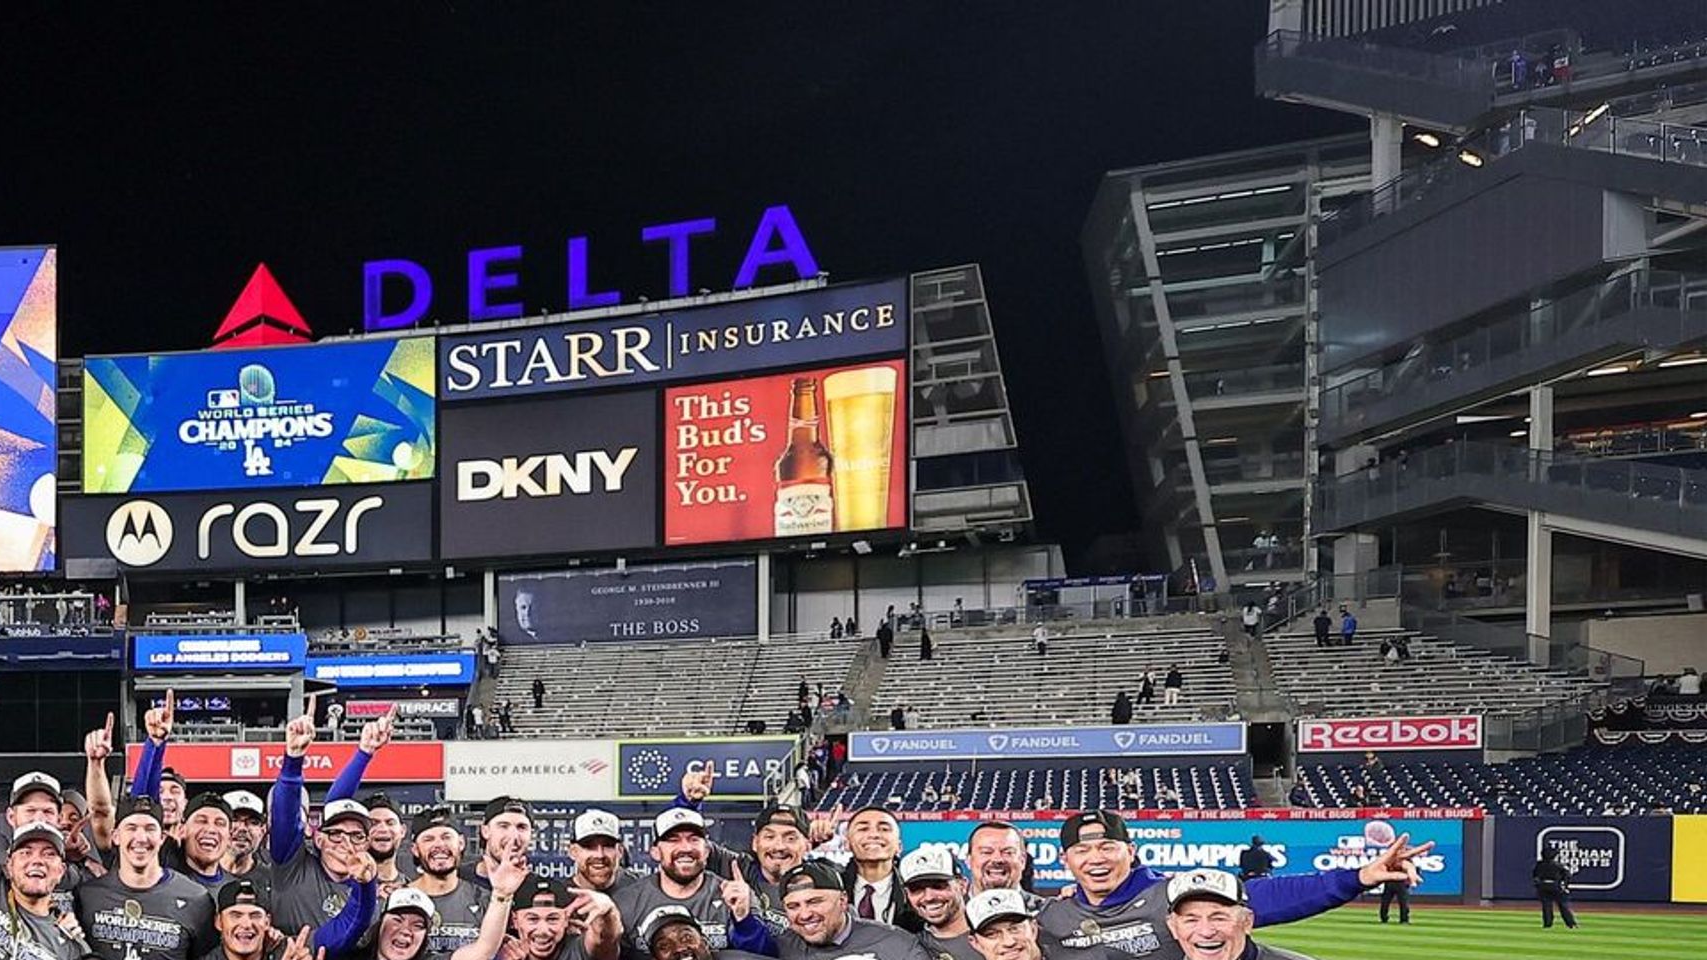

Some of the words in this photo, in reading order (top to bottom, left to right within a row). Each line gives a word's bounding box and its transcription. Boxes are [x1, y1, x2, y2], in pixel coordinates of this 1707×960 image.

[363, 204, 820, 331] DELTA
[447, 325, 660, 392] STARR
[679, 303, 896, 356] INSURANCE
[198, 406, 254, 419] WORLD
[257, 403, 314, 417] SERIES
[675, 393, 751, 422] This
[179, 412, 334, 444] CHAMPIONS
[675, 418, 768, 450] Bud's
[457, 447, 638, 501] DKNY
[675, 453, 733, 480] For
[675, 480, 748, 506] You.
[197, 496, 384, 560] razr
[610, 622, 646, 636] THE
[653, 619, 700, 635] BOSS
[399, 701, 457, 713] TERRACE
[1011, 736, 1080, 748] FANDUEL
[1139, 733, 1212, 746] FANDUEL
[1302, 719, 1479, 749] Reebok
[893, 739, 957, 751] FANDUEL
[266, 755, 333, 768] TOOTA
[450, 766, 489, 775] BANK
[491, 766, 509, 774] OF
[512, 765, 577, 775] AMERICA
[1548, 840, 1578, 849] THE
[1559, 849, 1613, 858] OTHAM
[94, 912, 137, 928] WORLD
[138, 916, 181, 933] SERIES
[440, 924, 481, 938] SERIES
[93, 925, 180, 949] CHAMPIONS
